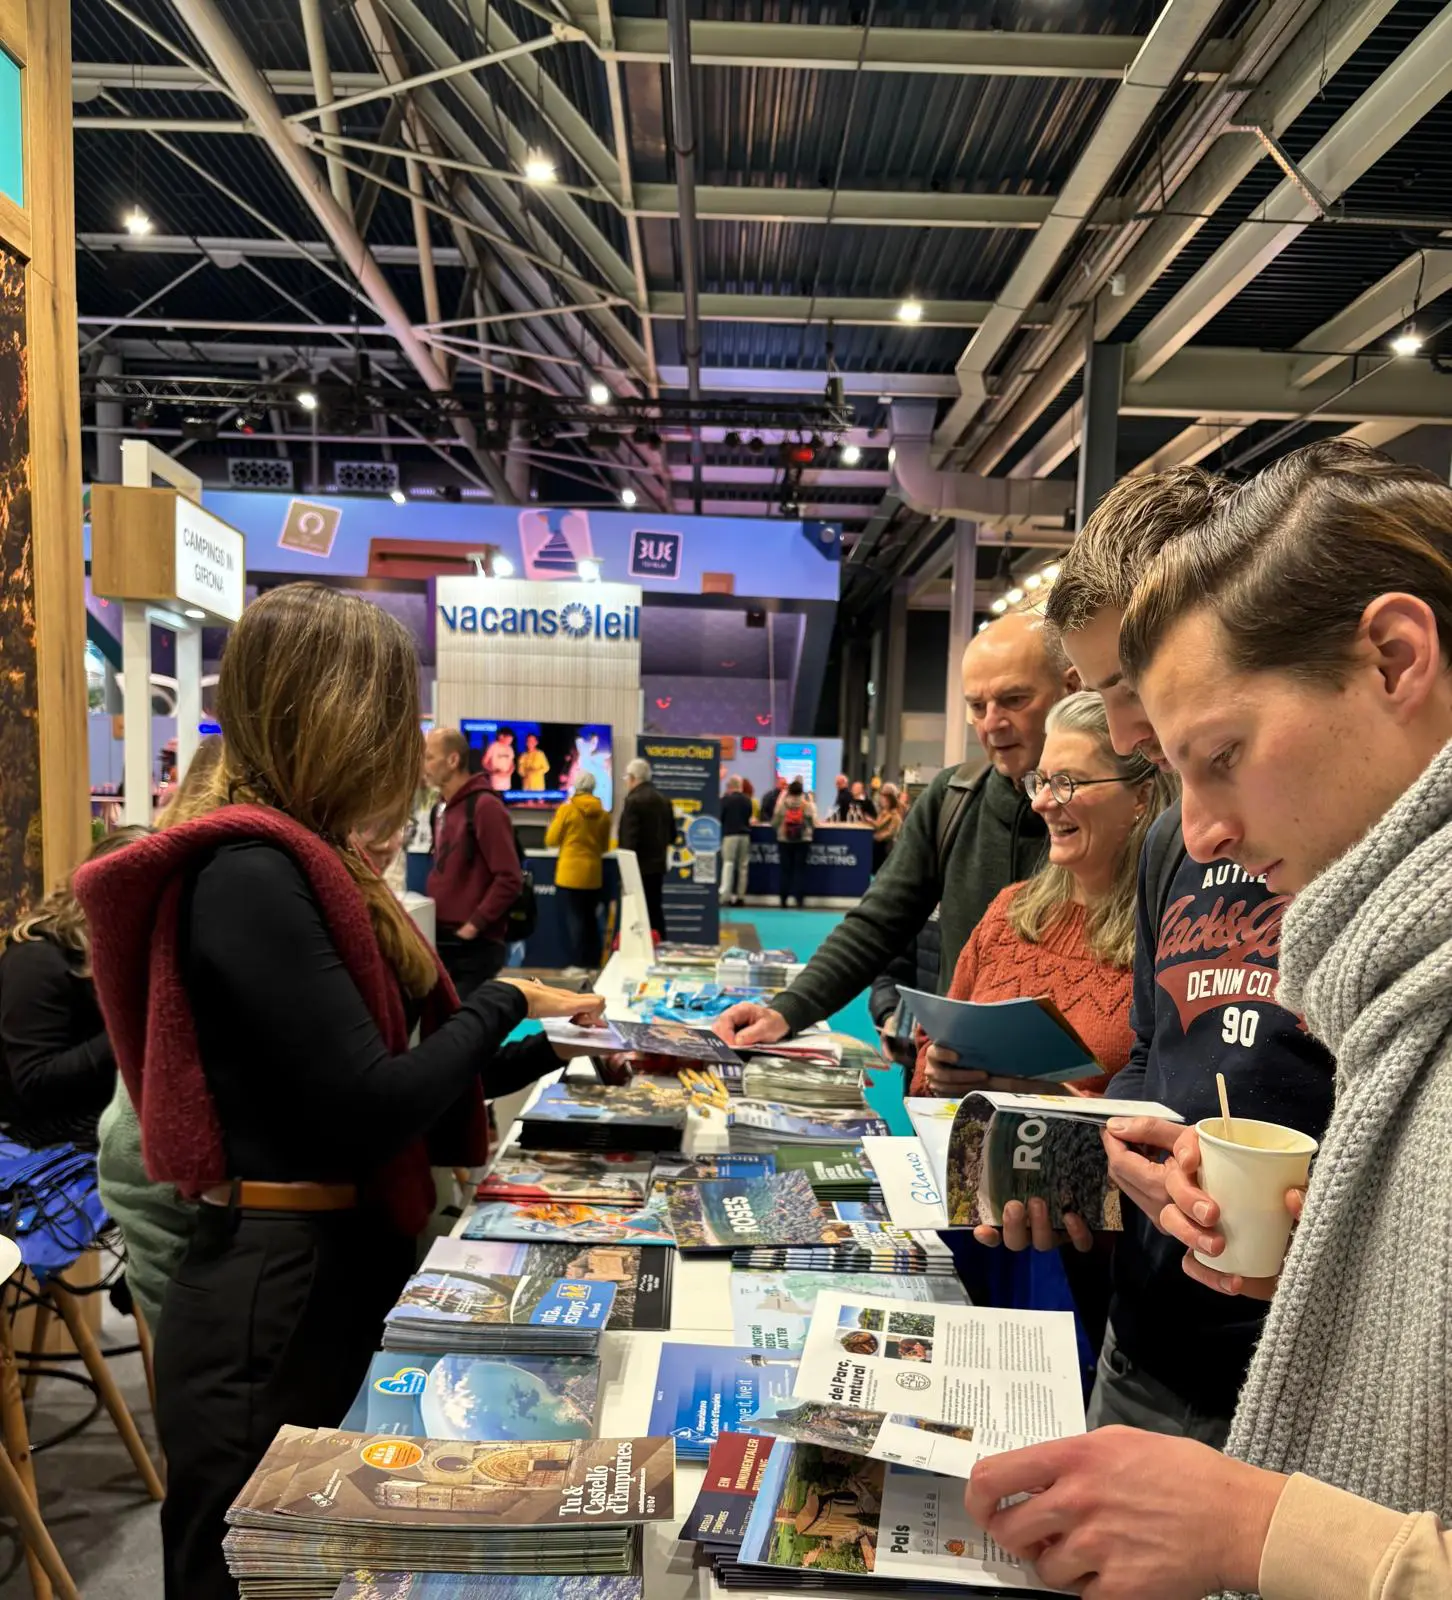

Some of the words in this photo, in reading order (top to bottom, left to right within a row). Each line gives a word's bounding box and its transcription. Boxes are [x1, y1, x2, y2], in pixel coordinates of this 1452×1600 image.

[184, 527, 225, 567] CAMPINGS
[226, 553, 234, 571] IN
[195, 563, 225, 594] GIRONA
[1187, 968, 1245, 1001] DENIM
[1246, 970, 1273, 998] CO.
[1221, 1006, 1260, 1048] 90
[909, 1152, 943, 1206] Blanes
[722, 1195, 760, 1234] ROSES
[562, 1300, 589, 1324] estanys
[776, 1328, 788, 1338] TER
[778, 1337, 789, 1349] AIX
[832, 1359, 852, 1384] Parc,
[848, 1364, 866, 1403] natural
[736, 1386, 752, 1399] live
[828, 1384, 845, 1400] del
[697, 1400, 707, 1432] Empuriabrava
[606, 1442, 637, 1514] d'Empúries
[735, 1438, 759, 1490] MONUMENTALER
[562, 1484, 584, 1496] &
[583, 1465, 609, 1514] Castelló
[718, 1477, 732, 1488] EIN
[559, 1498, 582, 1516] Tu
[890, 1524, 911, 1554] Pals
